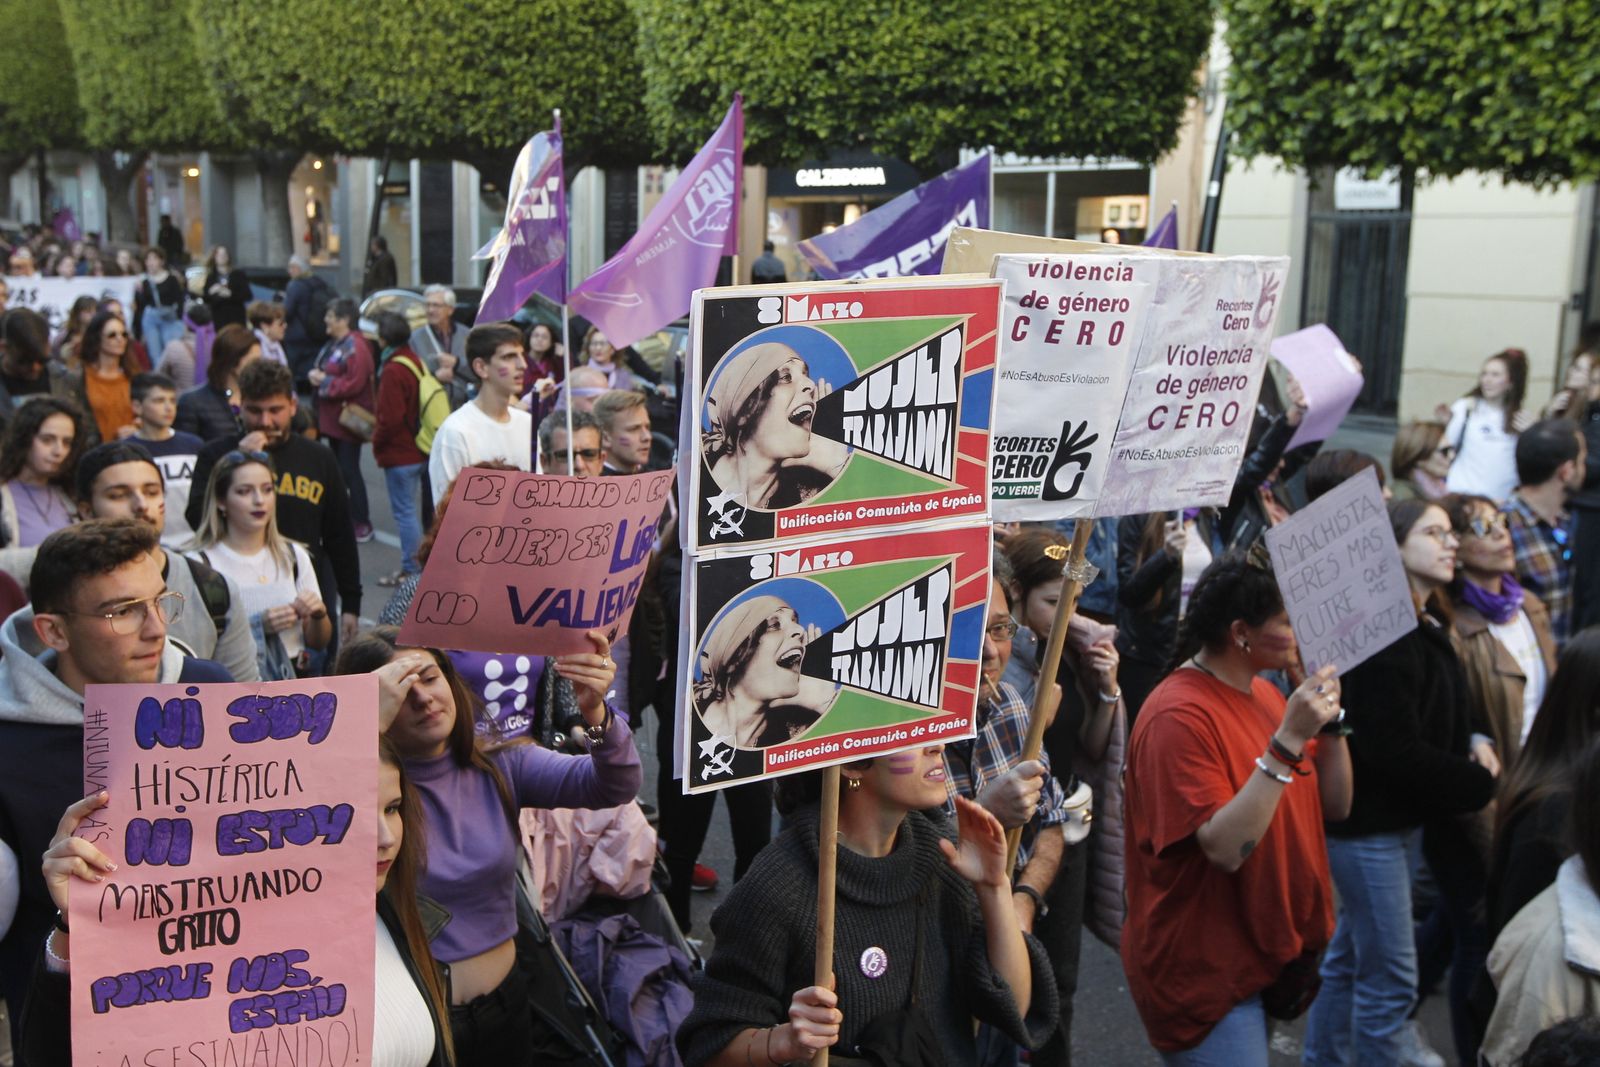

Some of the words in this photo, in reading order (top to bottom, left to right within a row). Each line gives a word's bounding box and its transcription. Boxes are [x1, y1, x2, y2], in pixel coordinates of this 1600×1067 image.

[1028, 259, 1134, 282] violencia
[757, 297, 781, 323] 8
[1019, 290, 1049, 311] de
[1058, 292, 1130, 315] género
[1216, 299, 1253, 312] Recortes
[1011, 316, 1125, 346] CERO
[1223, 314, 1249, 331] Cero
[843, 328, 961, 413] MUJER
[1166, 344, 1253, 366] Violencia
[1156, 376, 1181, 394] de
[1187, 374, 1247, 399] género
[1148, 401, 1240, 430] CERO
[843, 409, 953, 480] TRABAJADORA
[992, 455, 1049, 479] CERO
[463, 475, 506, 505] DE
[625, 479, 641, 504] A
[1009, 485, 1040, 496] VERDE
[780, 510, 852, 529] Unificación
[856, 502, 921, 519] Comunista
[925, 498, 939, 511] de
[942, 493, 982, 508] España
[568, 522, 613, 560] SER
[1278, 495, 1379, 571] MACHISTA
[750, 553, 773, 580] 8
[1288, 552, 1339, 604] ERES
[1296, 585, 1354, 645] CUTRE
[1363, 559, 1390, 584] QUE
[1368, 582, 1389, 596] MI
[415, 590, 478, 625] NO
[832, 568, 950, 653] MUJER
[1317, 599, 1413, 665] PANCARTA
[831, 642, 940, 707] TRABAJADORA
[226, 692, 337, 744] SOY
[768, 743, 839, 765] Unificación
[842, 731, 907, 749] Comunista
[910, 727, 925, 738] de
[928, 717, 968, 734] España
[216, 803, 354, 856] ESTOY
[100, 867, 322, 922] MENSTRUANDO
[158, 908, 240, 955] GRITO
[91, 962, 213, 1014] PORQUE
